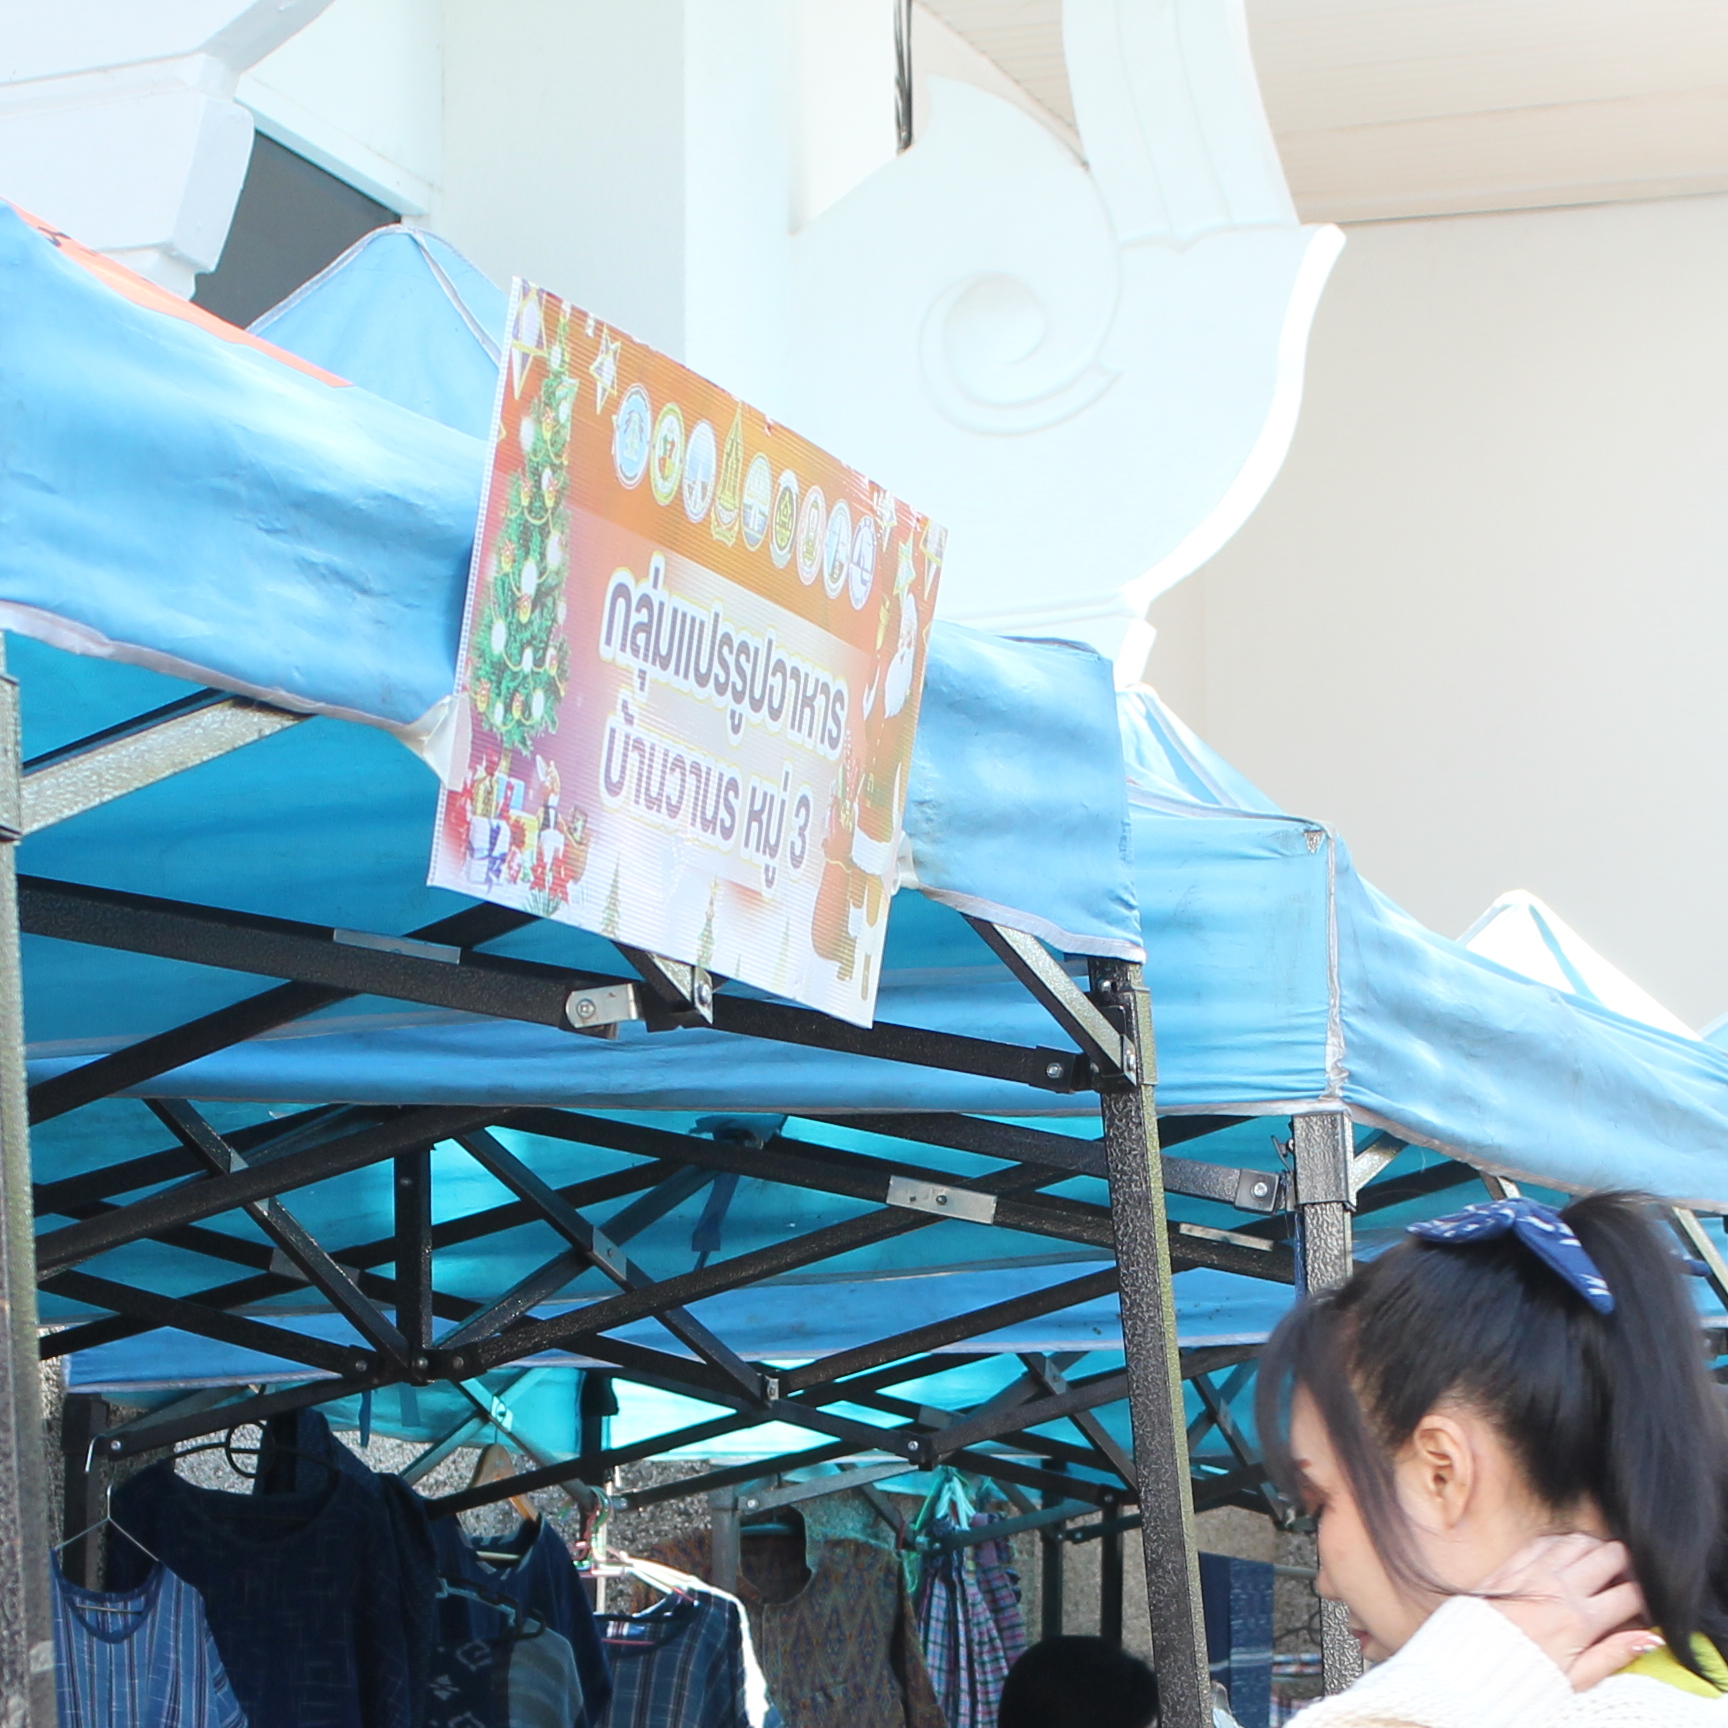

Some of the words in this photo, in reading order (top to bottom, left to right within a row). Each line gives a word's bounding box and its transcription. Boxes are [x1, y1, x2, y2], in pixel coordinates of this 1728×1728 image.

[605, 564, 847, 752] กลุ่มแปรรูปอาหาร
[603, 698, 739, 844] บ้านวานร
[743, 770, 789, 889] หมู่
[788, 789, 811, 870] 3
